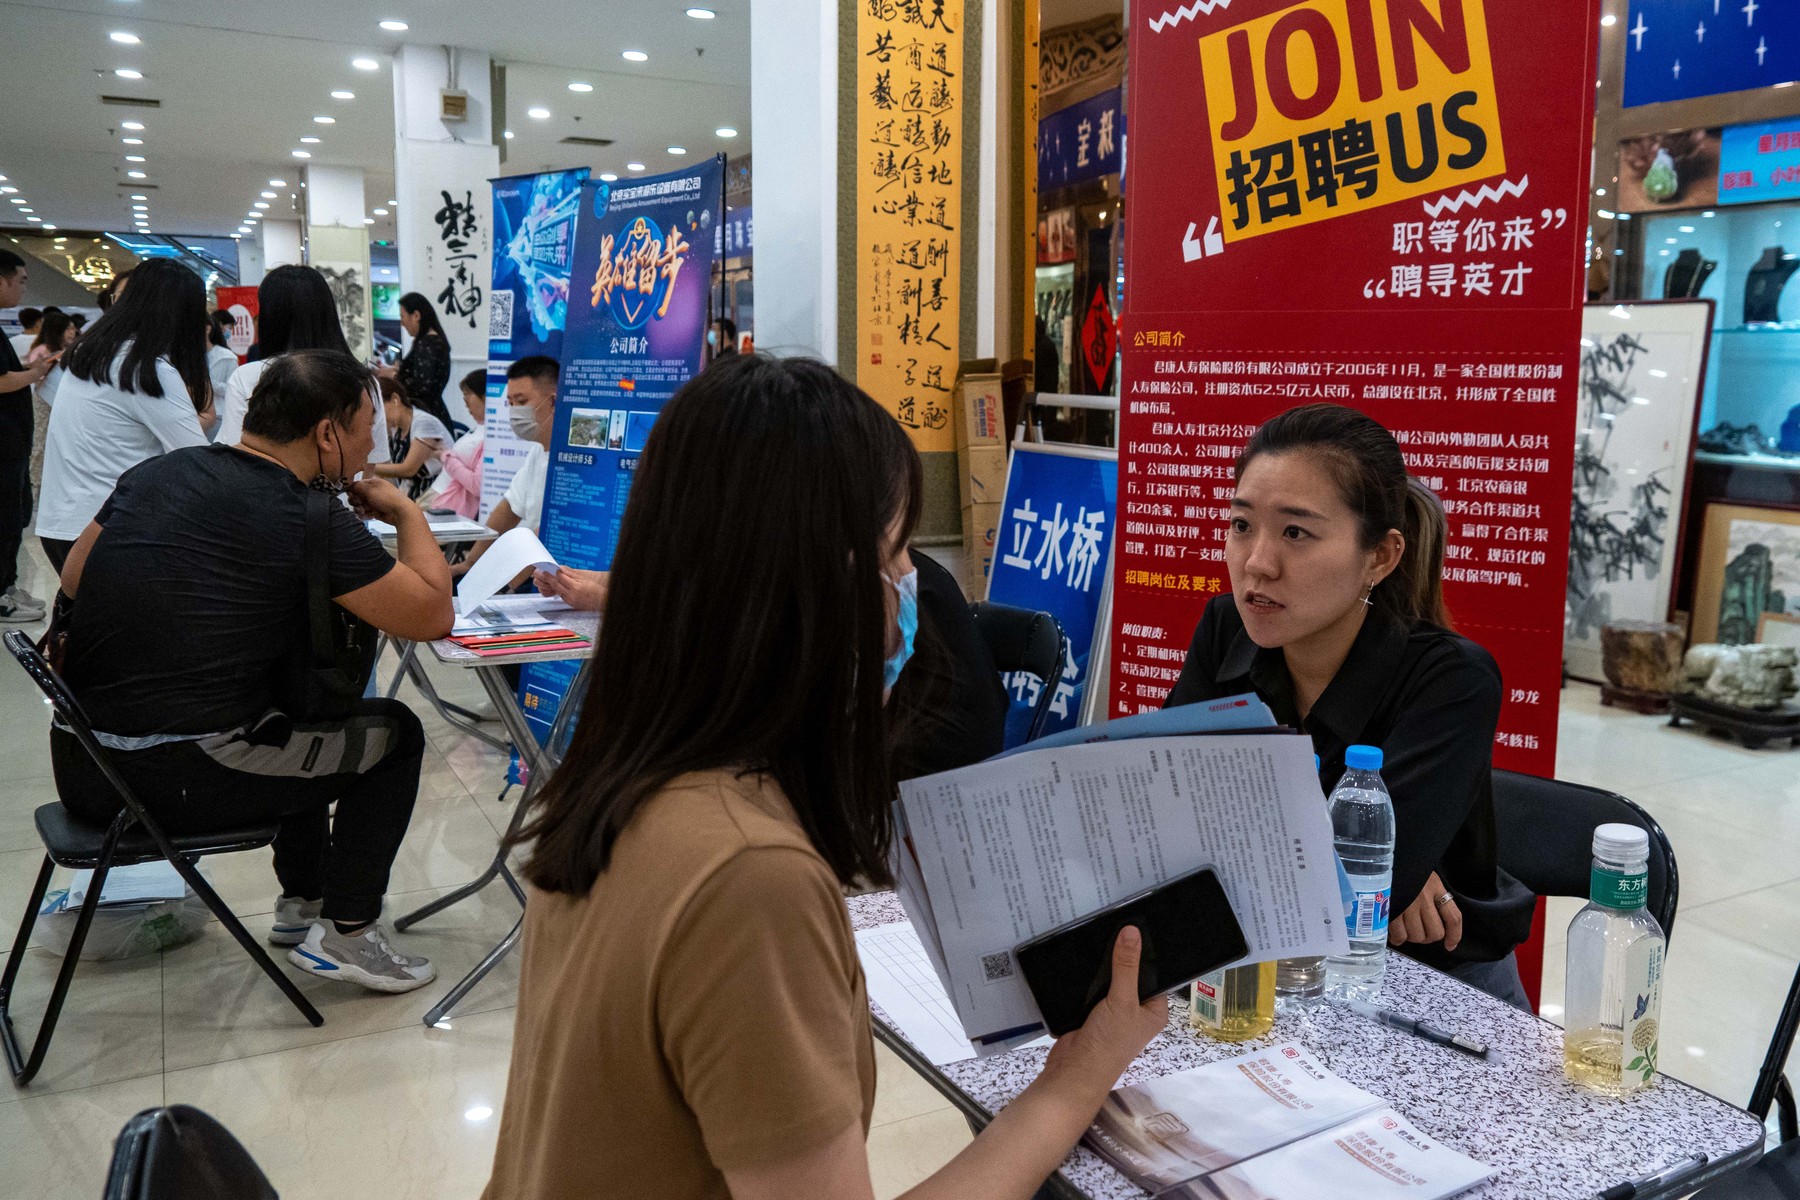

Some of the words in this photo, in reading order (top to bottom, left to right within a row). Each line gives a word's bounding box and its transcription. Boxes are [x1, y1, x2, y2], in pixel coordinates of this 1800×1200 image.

[1219, 0, 1472, 142] JOIN
[590, 223, 690, 317] 英雄留步
[609, 336, 649, 355] 公司简介
[1133, 330, 1186, 348] 公司简介
[1129, 401, 1176, 416] 机构布局。
[1152, 422, 1259, 437] 君康人寿北京分公司
[1128, 441, 1248, 459] 计400余人，公司拥有
[1002, 498, 1106, 593] 立水桥
[1124, 540, 1229, 561] 管理，打造了一支团
[1125, 569, 1221, 592] 招聘岗位及要求
[1119, 681, 1172, 700] 2、管理所
[1510, 688, 1541, 705] 沙龙
